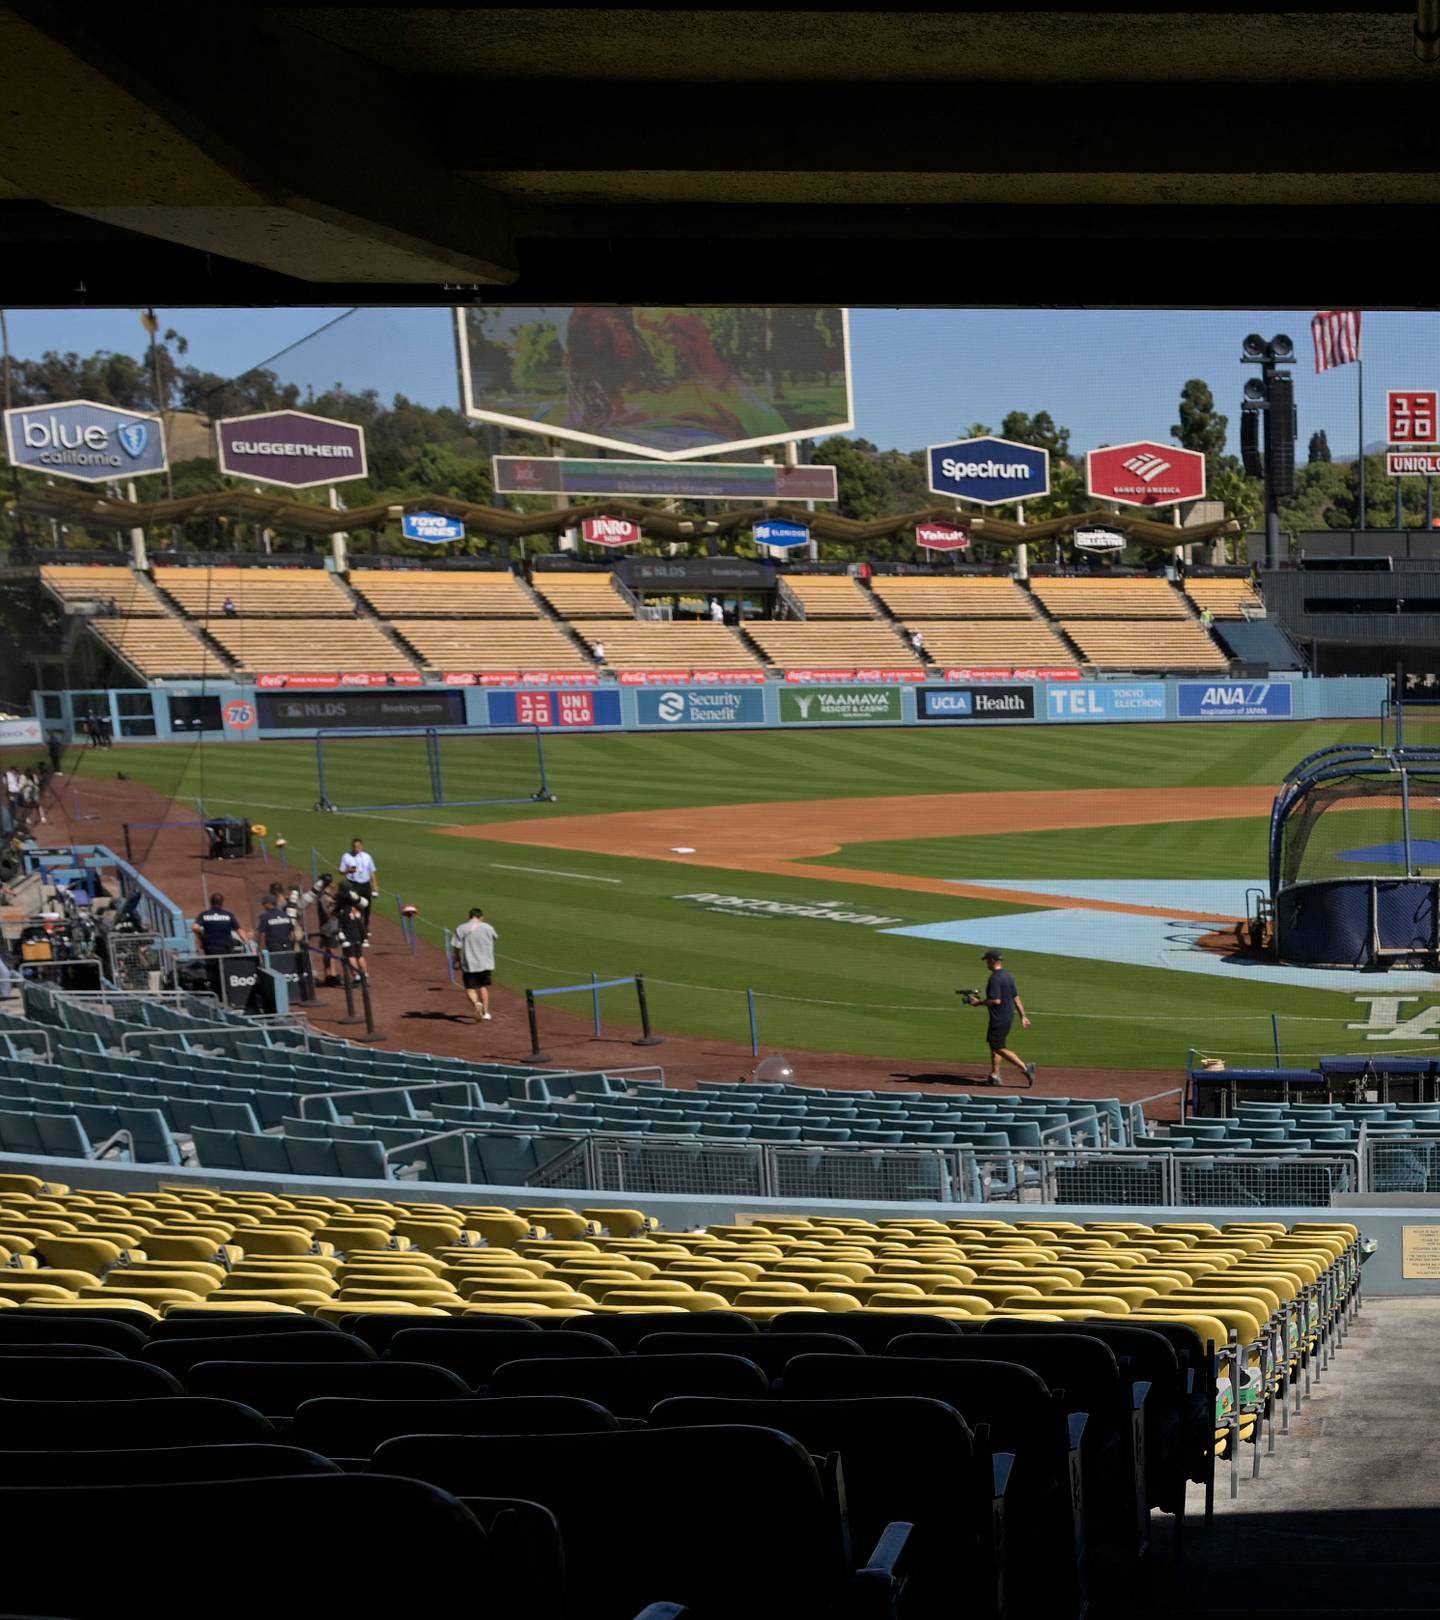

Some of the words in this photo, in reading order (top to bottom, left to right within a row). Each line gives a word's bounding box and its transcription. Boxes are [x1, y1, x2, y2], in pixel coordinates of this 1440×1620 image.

[23, 415, 109, 449] blue
[232, 440, 353, 458] GUGGENHEIM
[40, 451, 122, 467] california
[942, 459, 1030, 481] Spectrum
[1113, 486, 1134, 494] BANK
[1136, 486, 1145, 494] OF
[1147, 486, 1180, 494] AMERICA
[410, 516, 447, 527] TOYO
[592, 519, 632, 538] JINRO
[417, 527, 457, 537] TIRES
[920, 530, 964, 541] Yakult
[688, 692, 741, 706] Security
[1113, 689, 1144, 697] TOKYO
[1201, 687, 1245, 705] ANA
[562, 695, 588, 707] UNI
[932, 696, 966, 709] UCLA
[975, 694, 1025, 710] Health
[1050, 690, 1104, 713] TEL
[231, 707, 249, 722] 76
[304, 703, 347, 716] NLDS
[691, 707, 735, 721] Benefit
[563, 710, 590, 724] QLO
